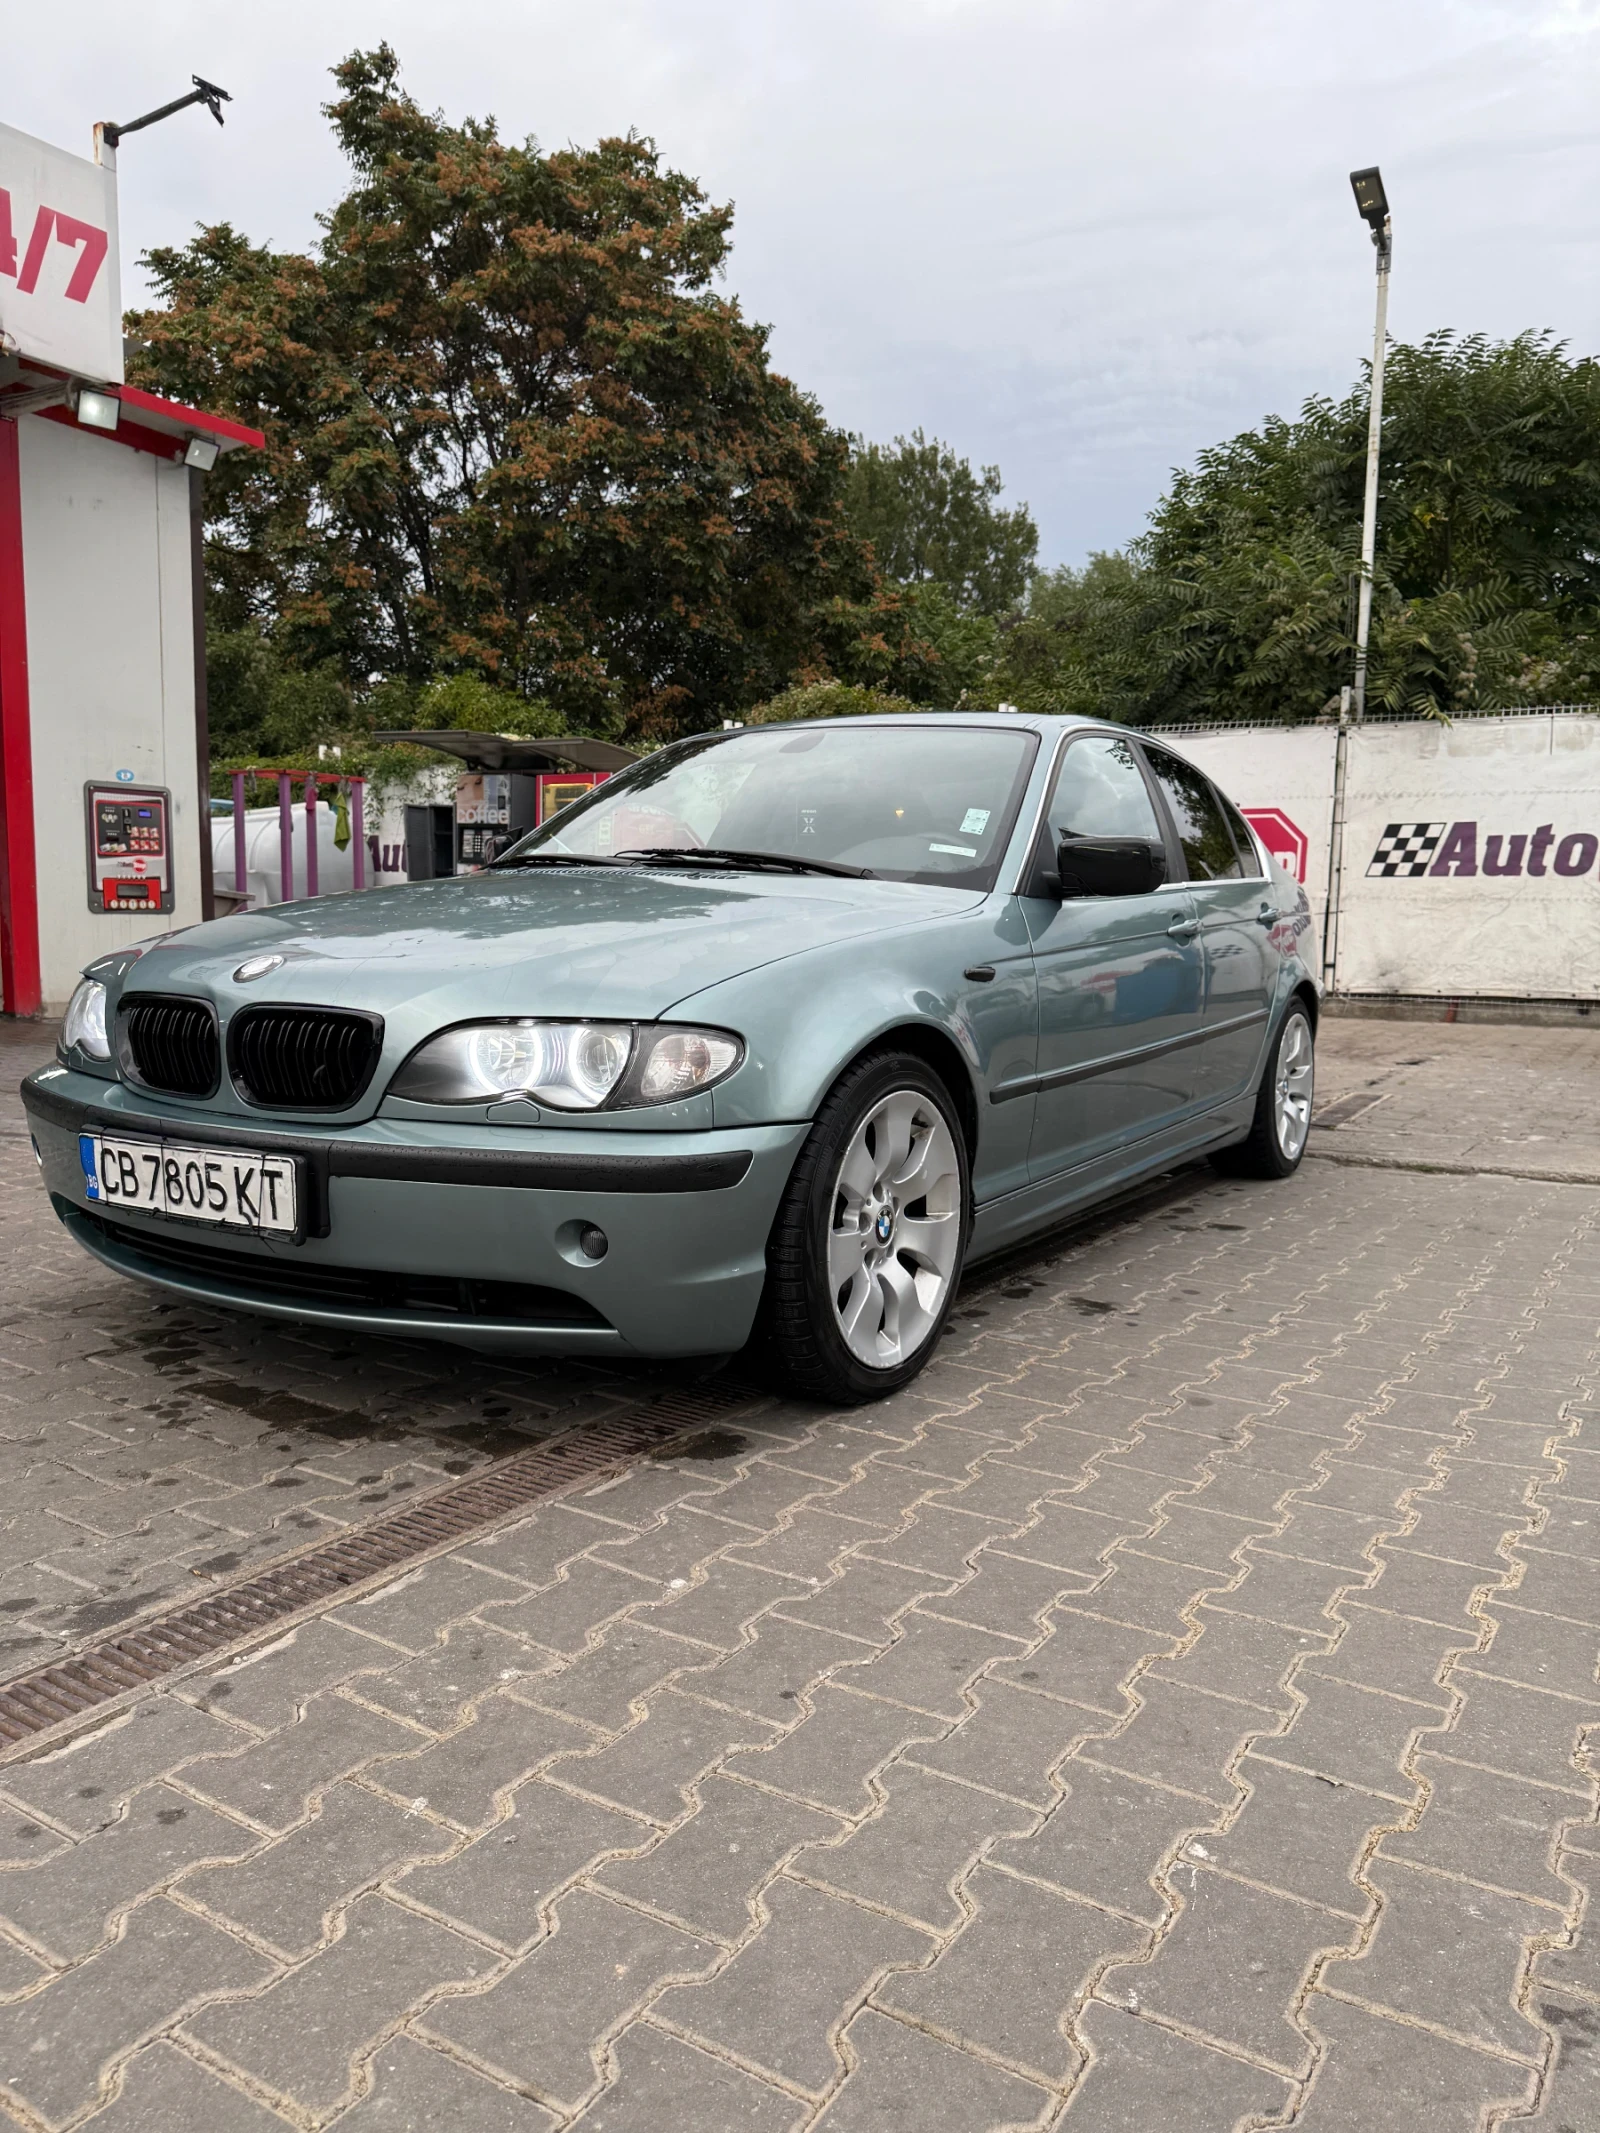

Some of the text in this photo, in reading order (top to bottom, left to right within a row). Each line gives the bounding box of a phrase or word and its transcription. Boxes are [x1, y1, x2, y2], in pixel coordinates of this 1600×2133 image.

[457, 804, 509, 824] coffee
[1428, 821, 1599, 877] Auto
[87, 1173, 98, 1189] BG
[100, 1148, 283, 1220] CB 7805 KT
